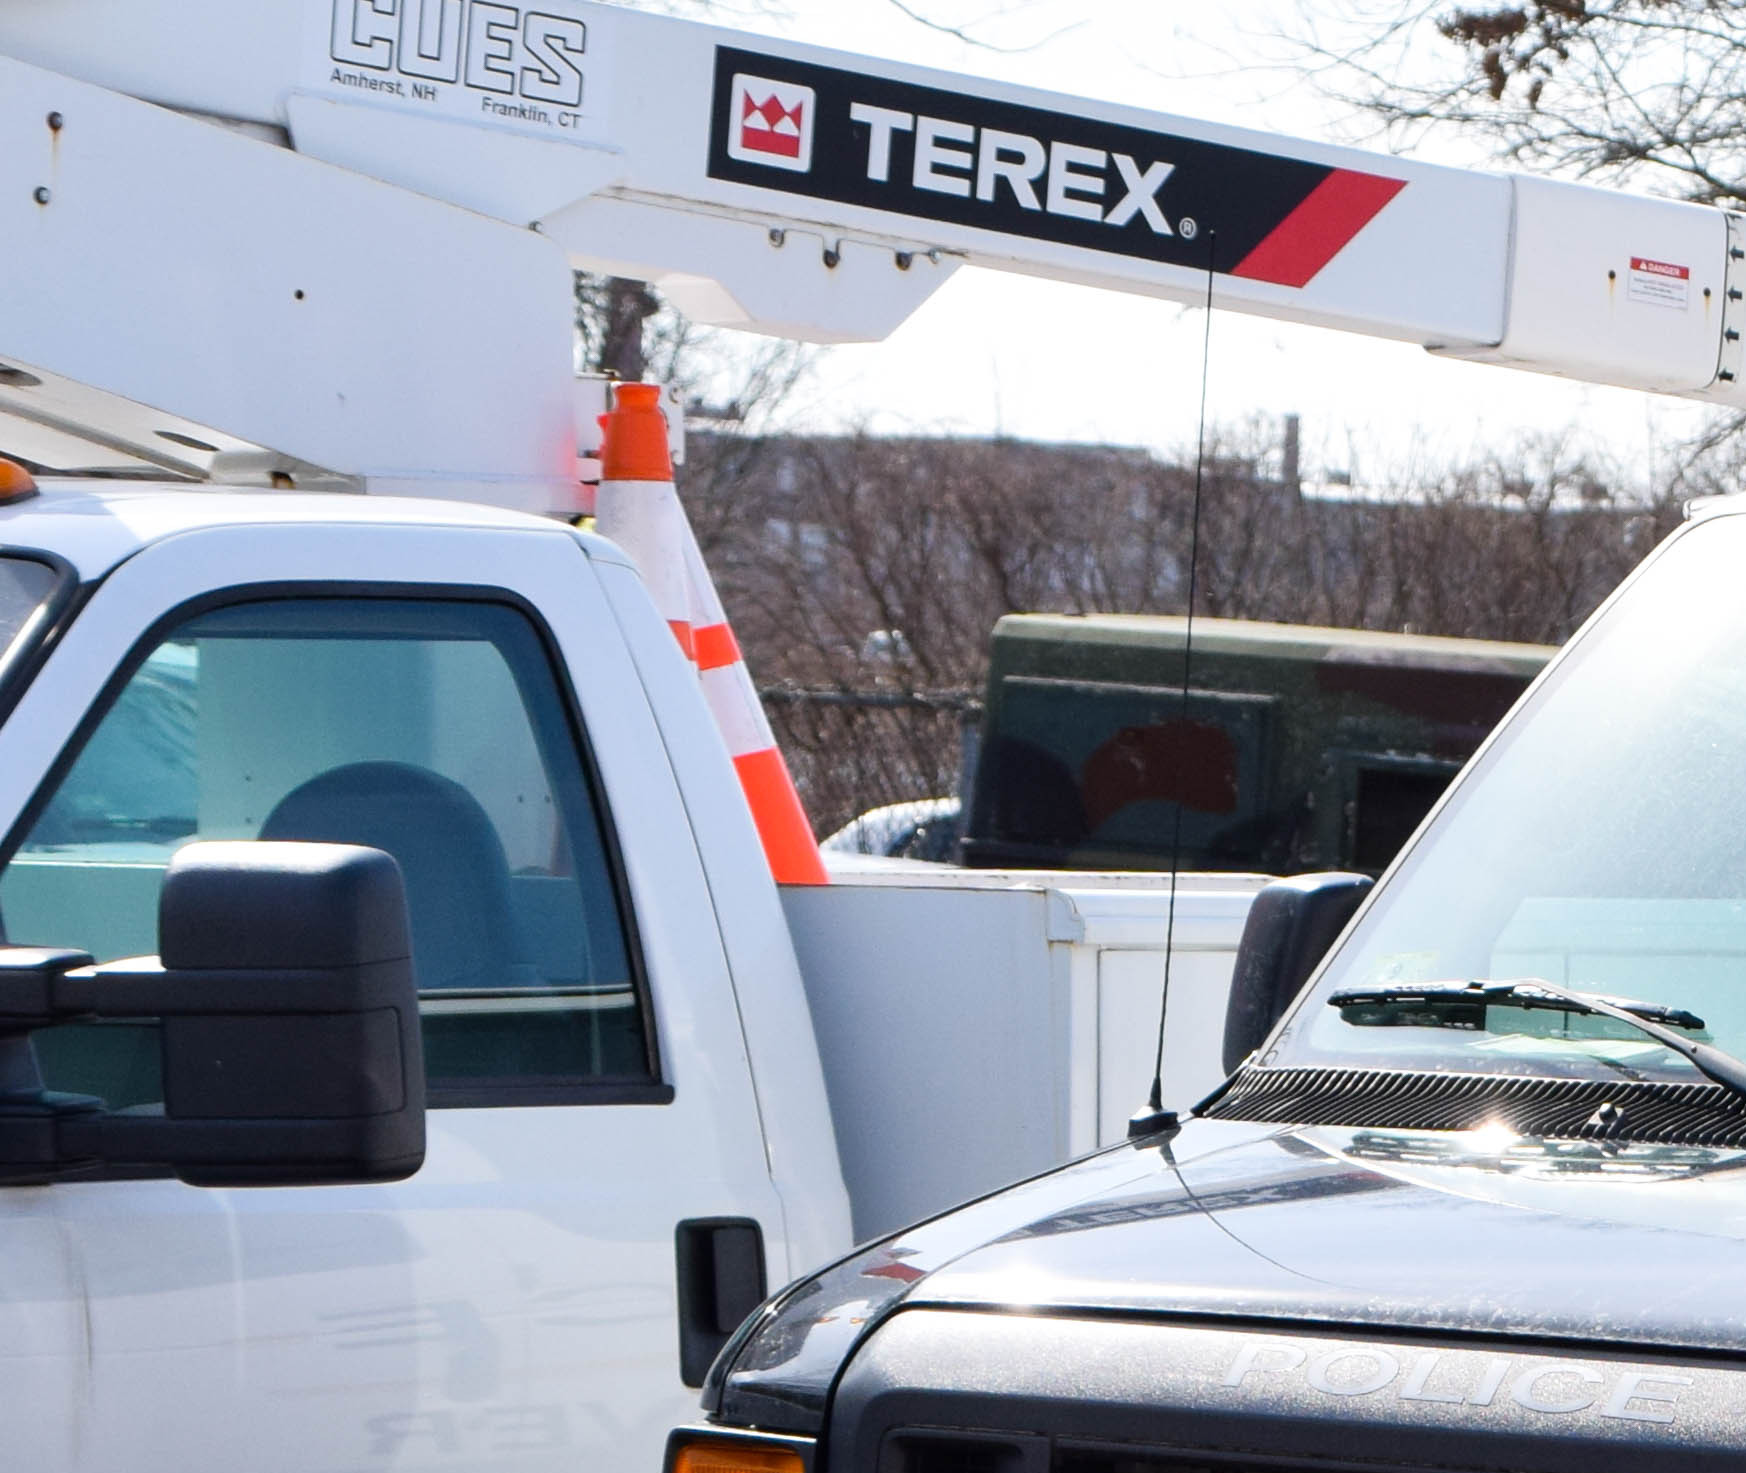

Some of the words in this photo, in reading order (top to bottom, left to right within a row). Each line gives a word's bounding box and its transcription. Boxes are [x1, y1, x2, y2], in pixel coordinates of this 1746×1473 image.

[330, 0, 586, 107] CUES
[330, 68, 405, 97] Amherst,
[411, 84, 437, 101] NH
[481, 96, 551, 126] Franklin,
[558, 111, 582, 128] CT
[1220, 1342, 1694, 1424] POLICE
